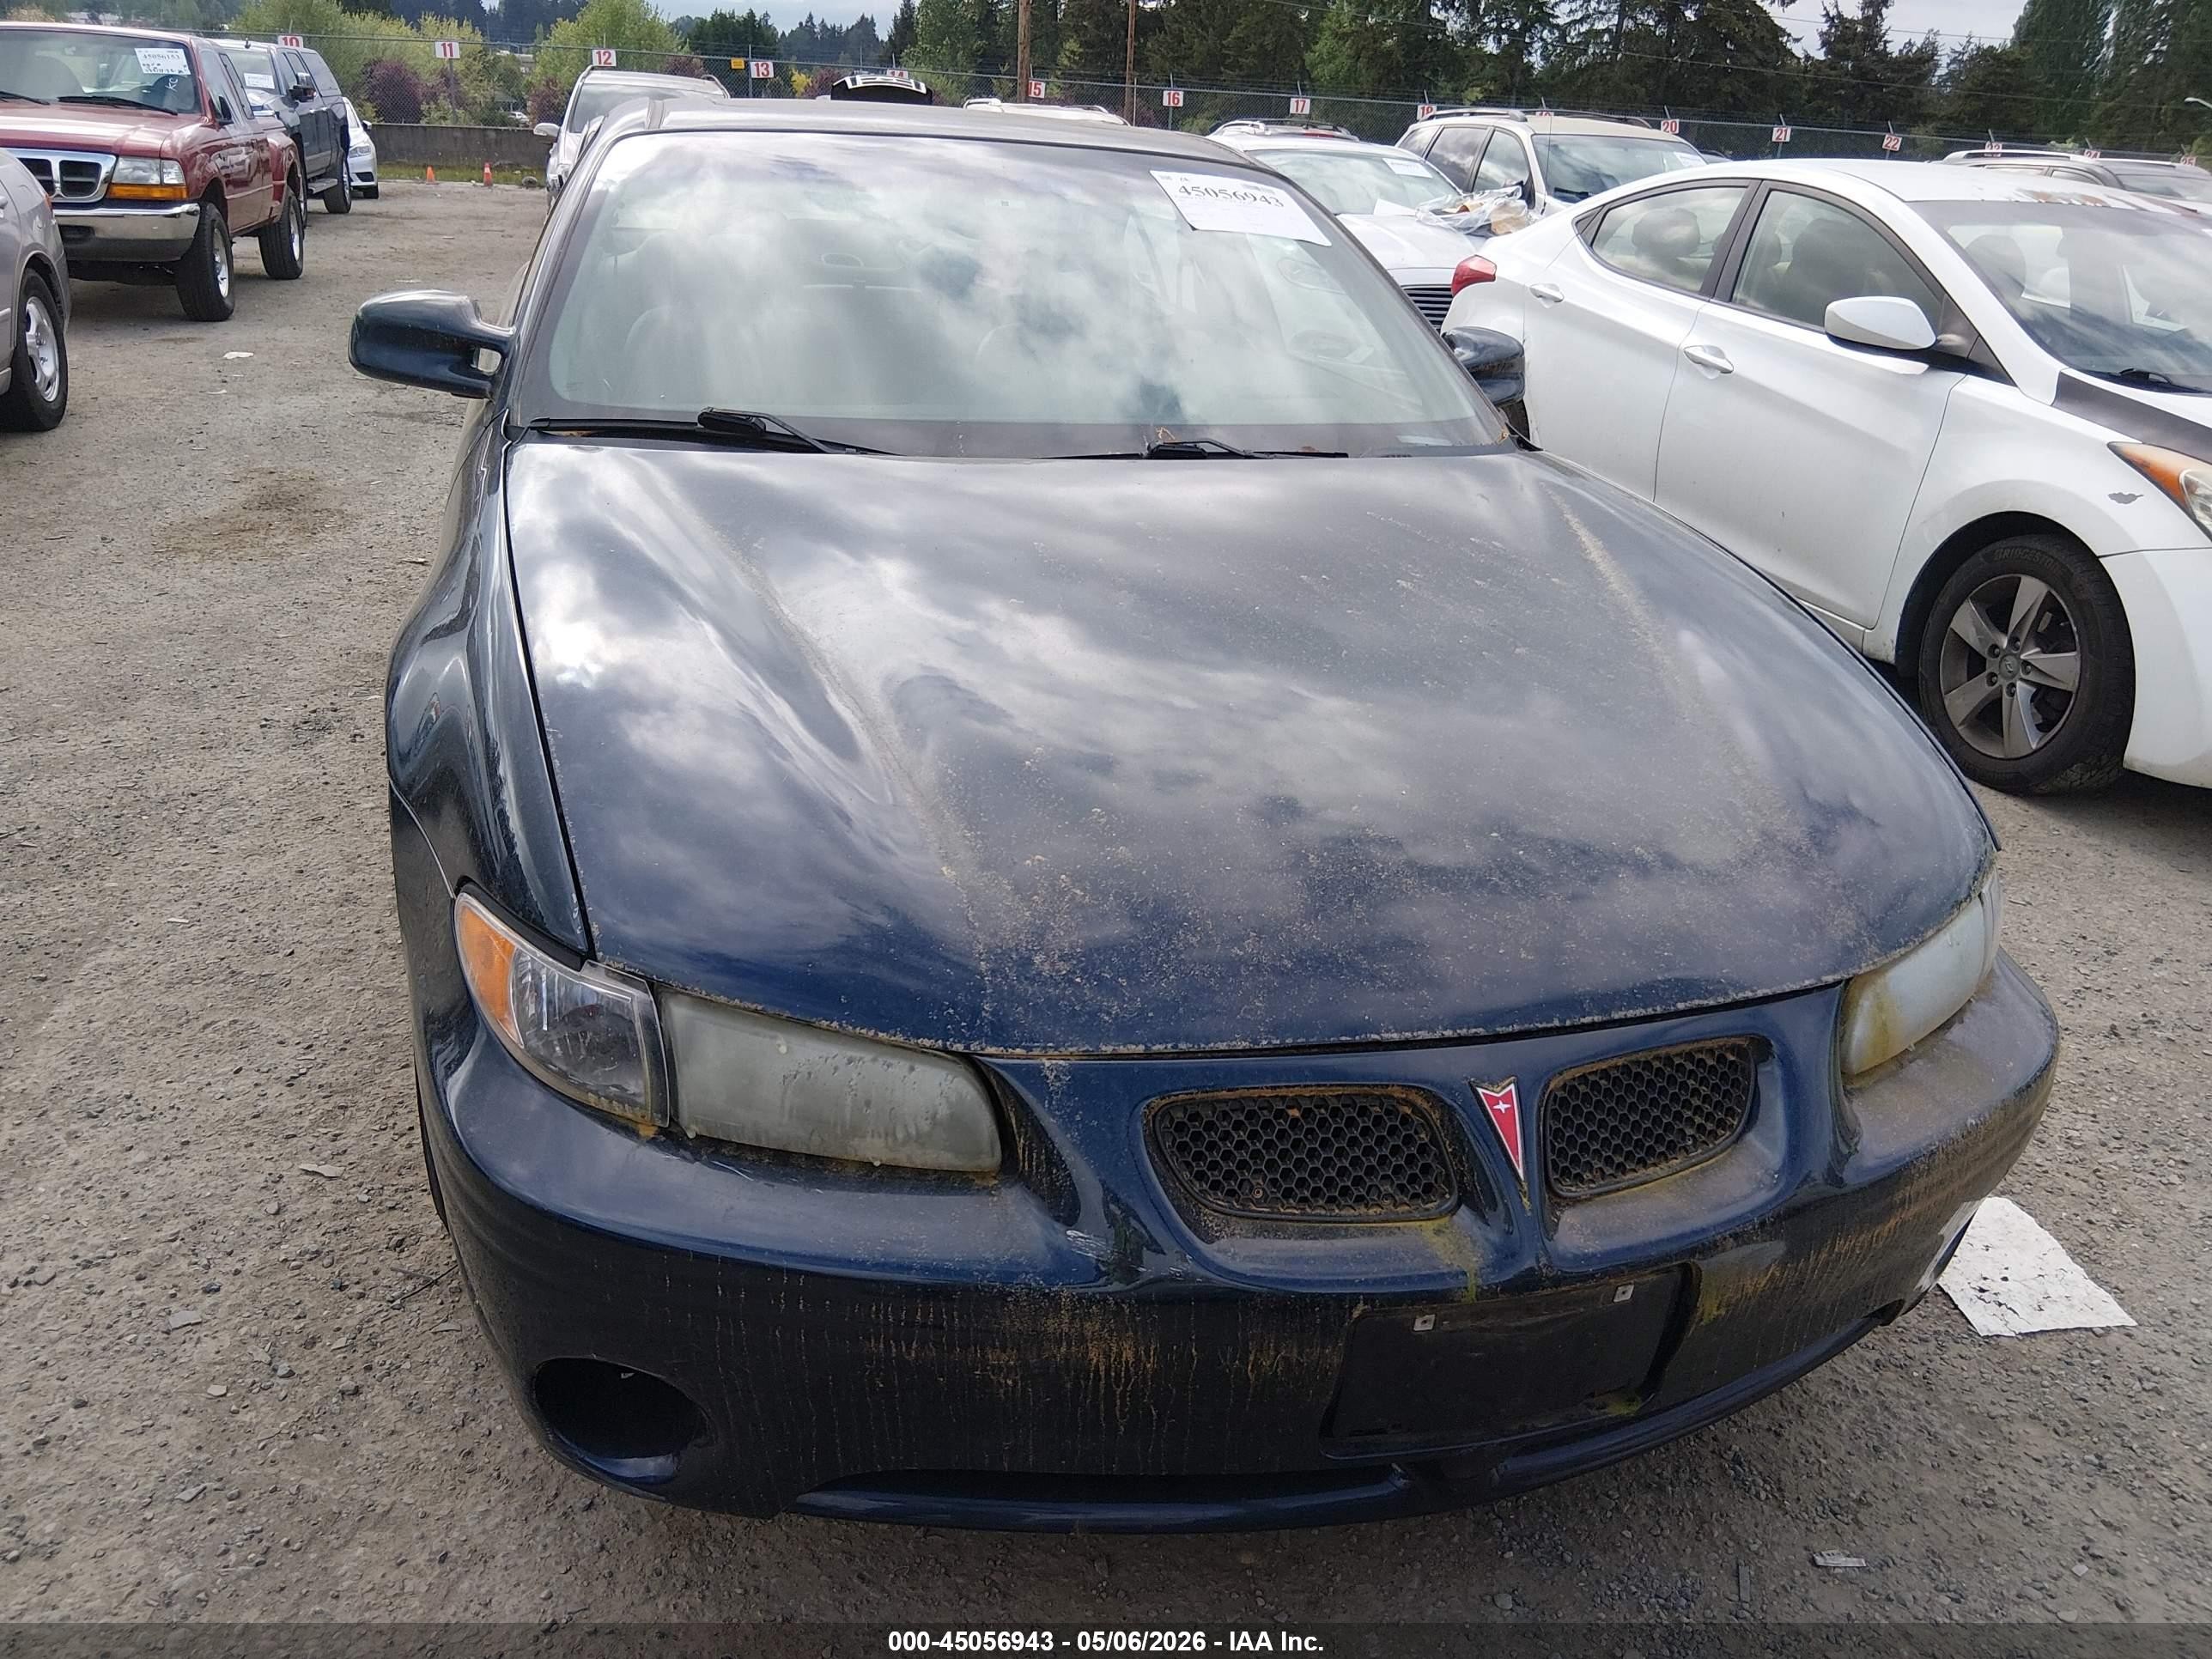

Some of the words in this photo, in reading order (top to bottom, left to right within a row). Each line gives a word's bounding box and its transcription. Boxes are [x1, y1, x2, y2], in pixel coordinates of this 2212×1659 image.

[441, 42, 454, 58] 11
[595, 50, 612, 65] 12
[754, 62, 770, 77] 13
[1028, 82, 1042, 97] 15
[1167, 91, 1181, 106] 16
[1294, 99, 1307, 113] 17
[1662, 120, 1678, 133] 20
[1775, 128, 1789, 141] 21
[1884, 136, 1900, 149] 22
[1178, 185, 1285, 208] 45056943
